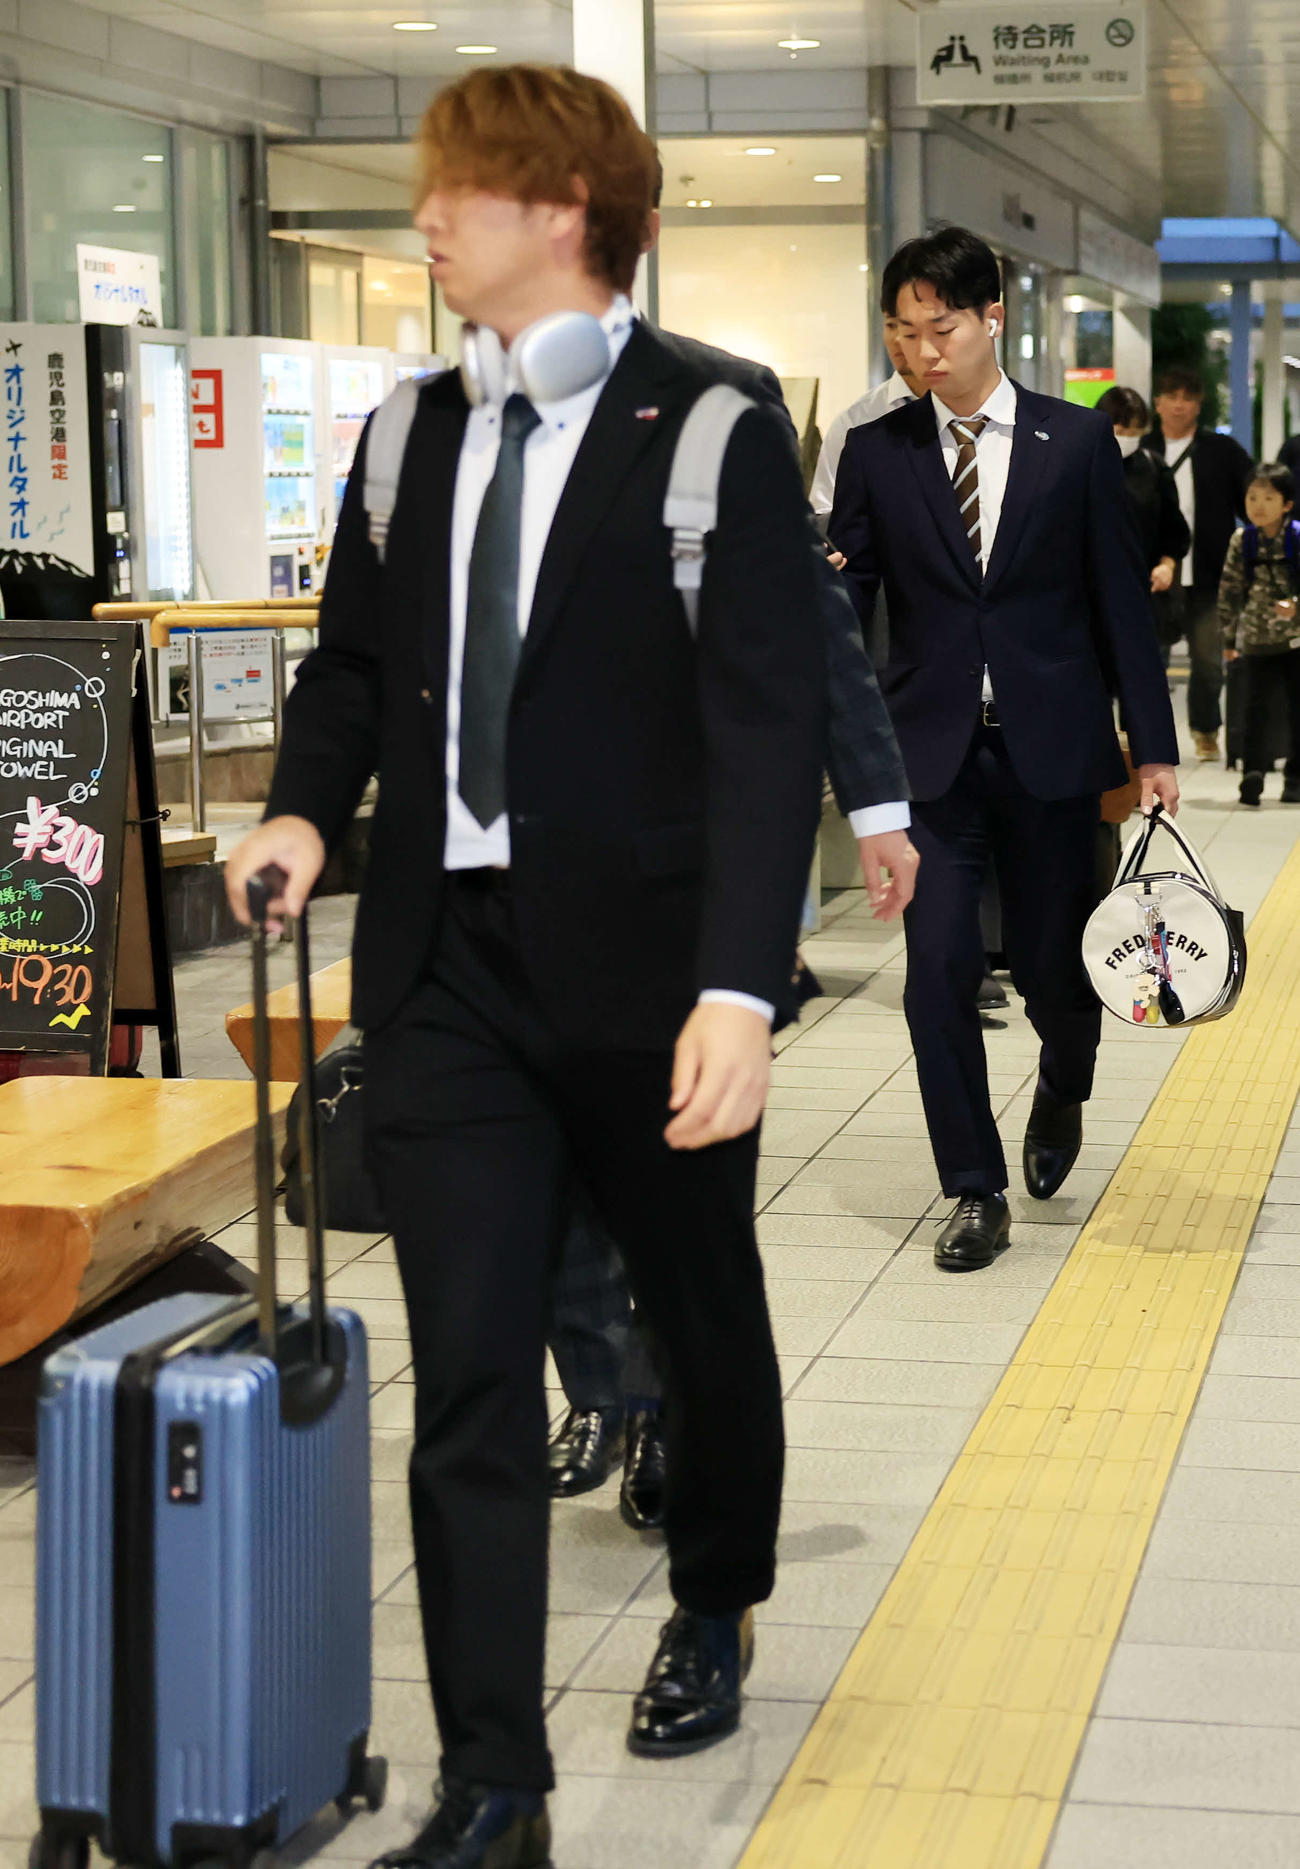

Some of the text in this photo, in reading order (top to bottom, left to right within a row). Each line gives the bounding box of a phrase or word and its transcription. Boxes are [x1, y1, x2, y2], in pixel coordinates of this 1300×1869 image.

[992, 23, 1075, 49] 待合所
[993, 53, 1090, 69] Waiting Area
[48, 353, 69, 481] 鹿児島空港限定
[4, 363, 30, 540] オリジナルタオル
[0, 689, 81, 709] GOSHIMA
[0, 737, 77, 758] IGINAL
[12, 796, 105, 886] ¥300
[1105, 931, 1208, 970] FRED ERRY
